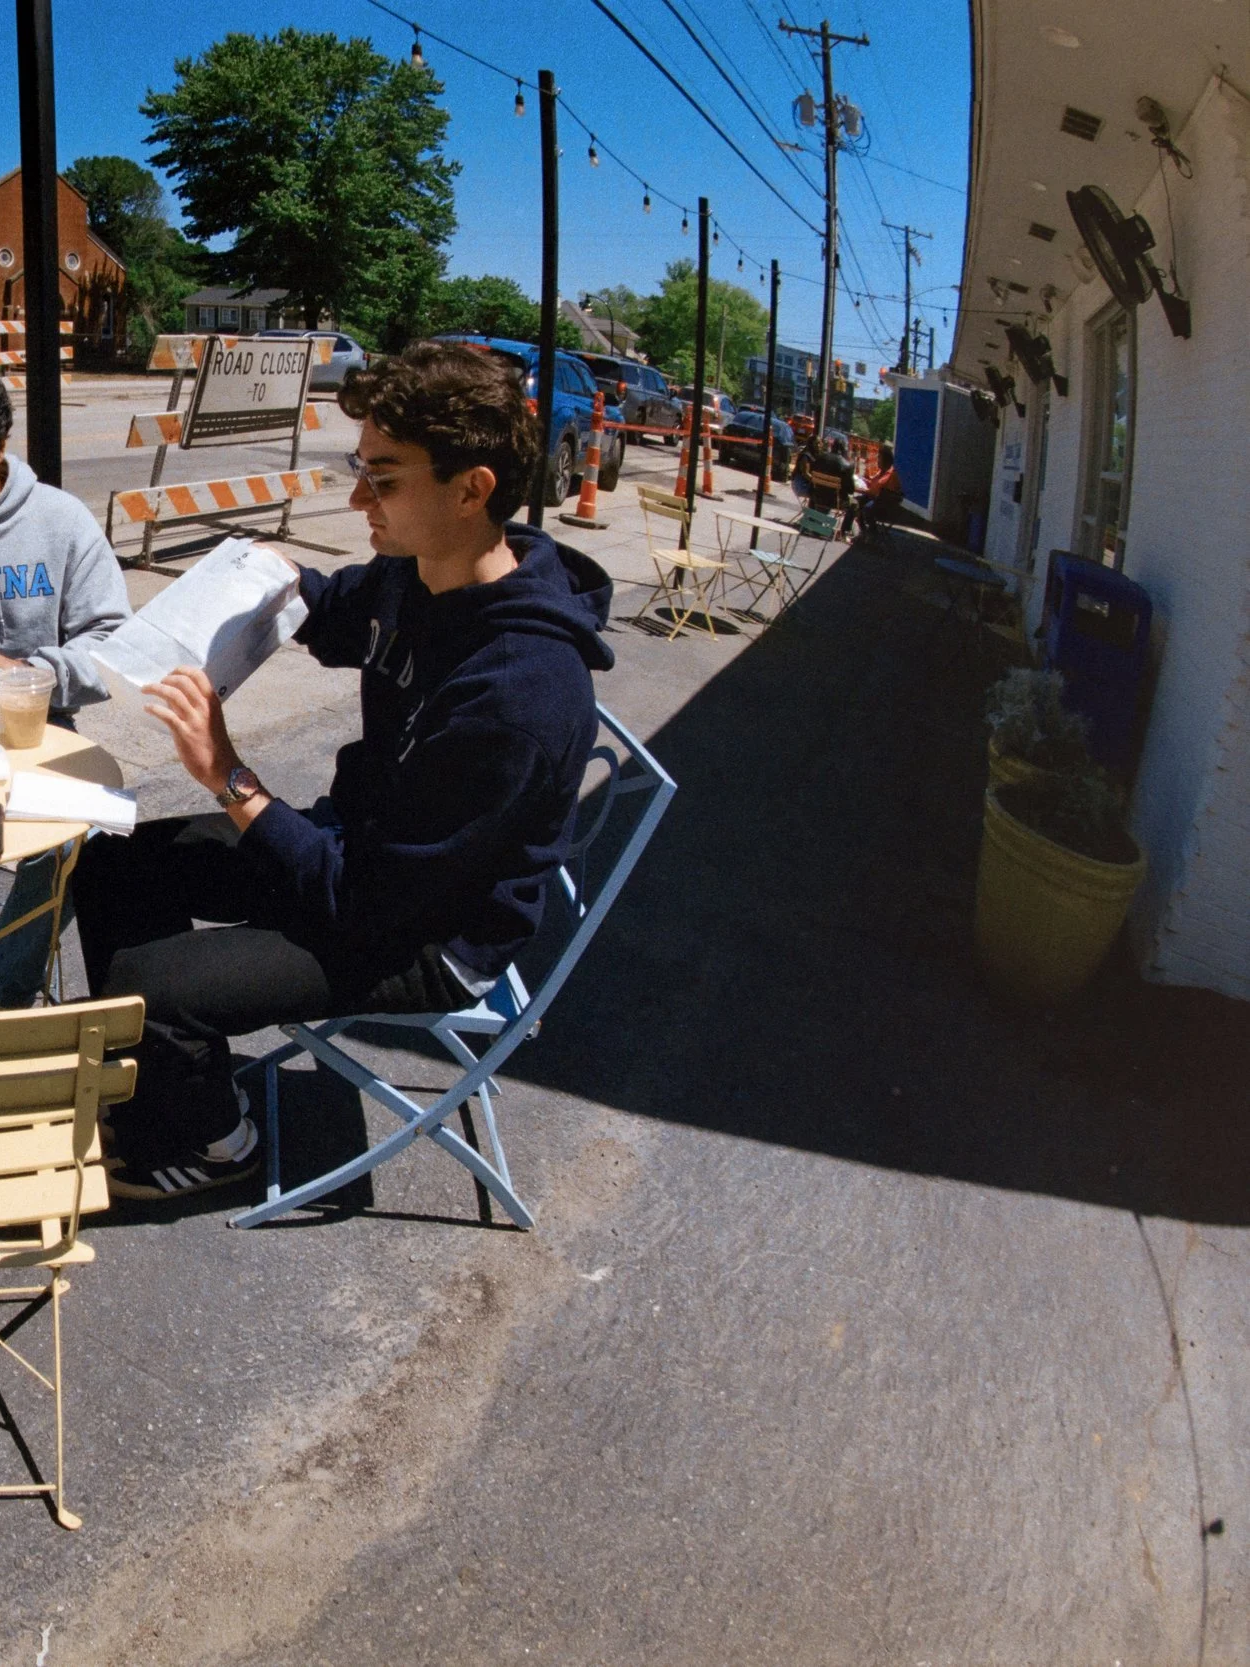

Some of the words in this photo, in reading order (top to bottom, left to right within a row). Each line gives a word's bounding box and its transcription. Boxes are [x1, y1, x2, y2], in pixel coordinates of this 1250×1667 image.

[212, 351, 254, 375] ROAD
[260, 351, 306, 375] CLOSED
[252, 383, 266, 402] TO
